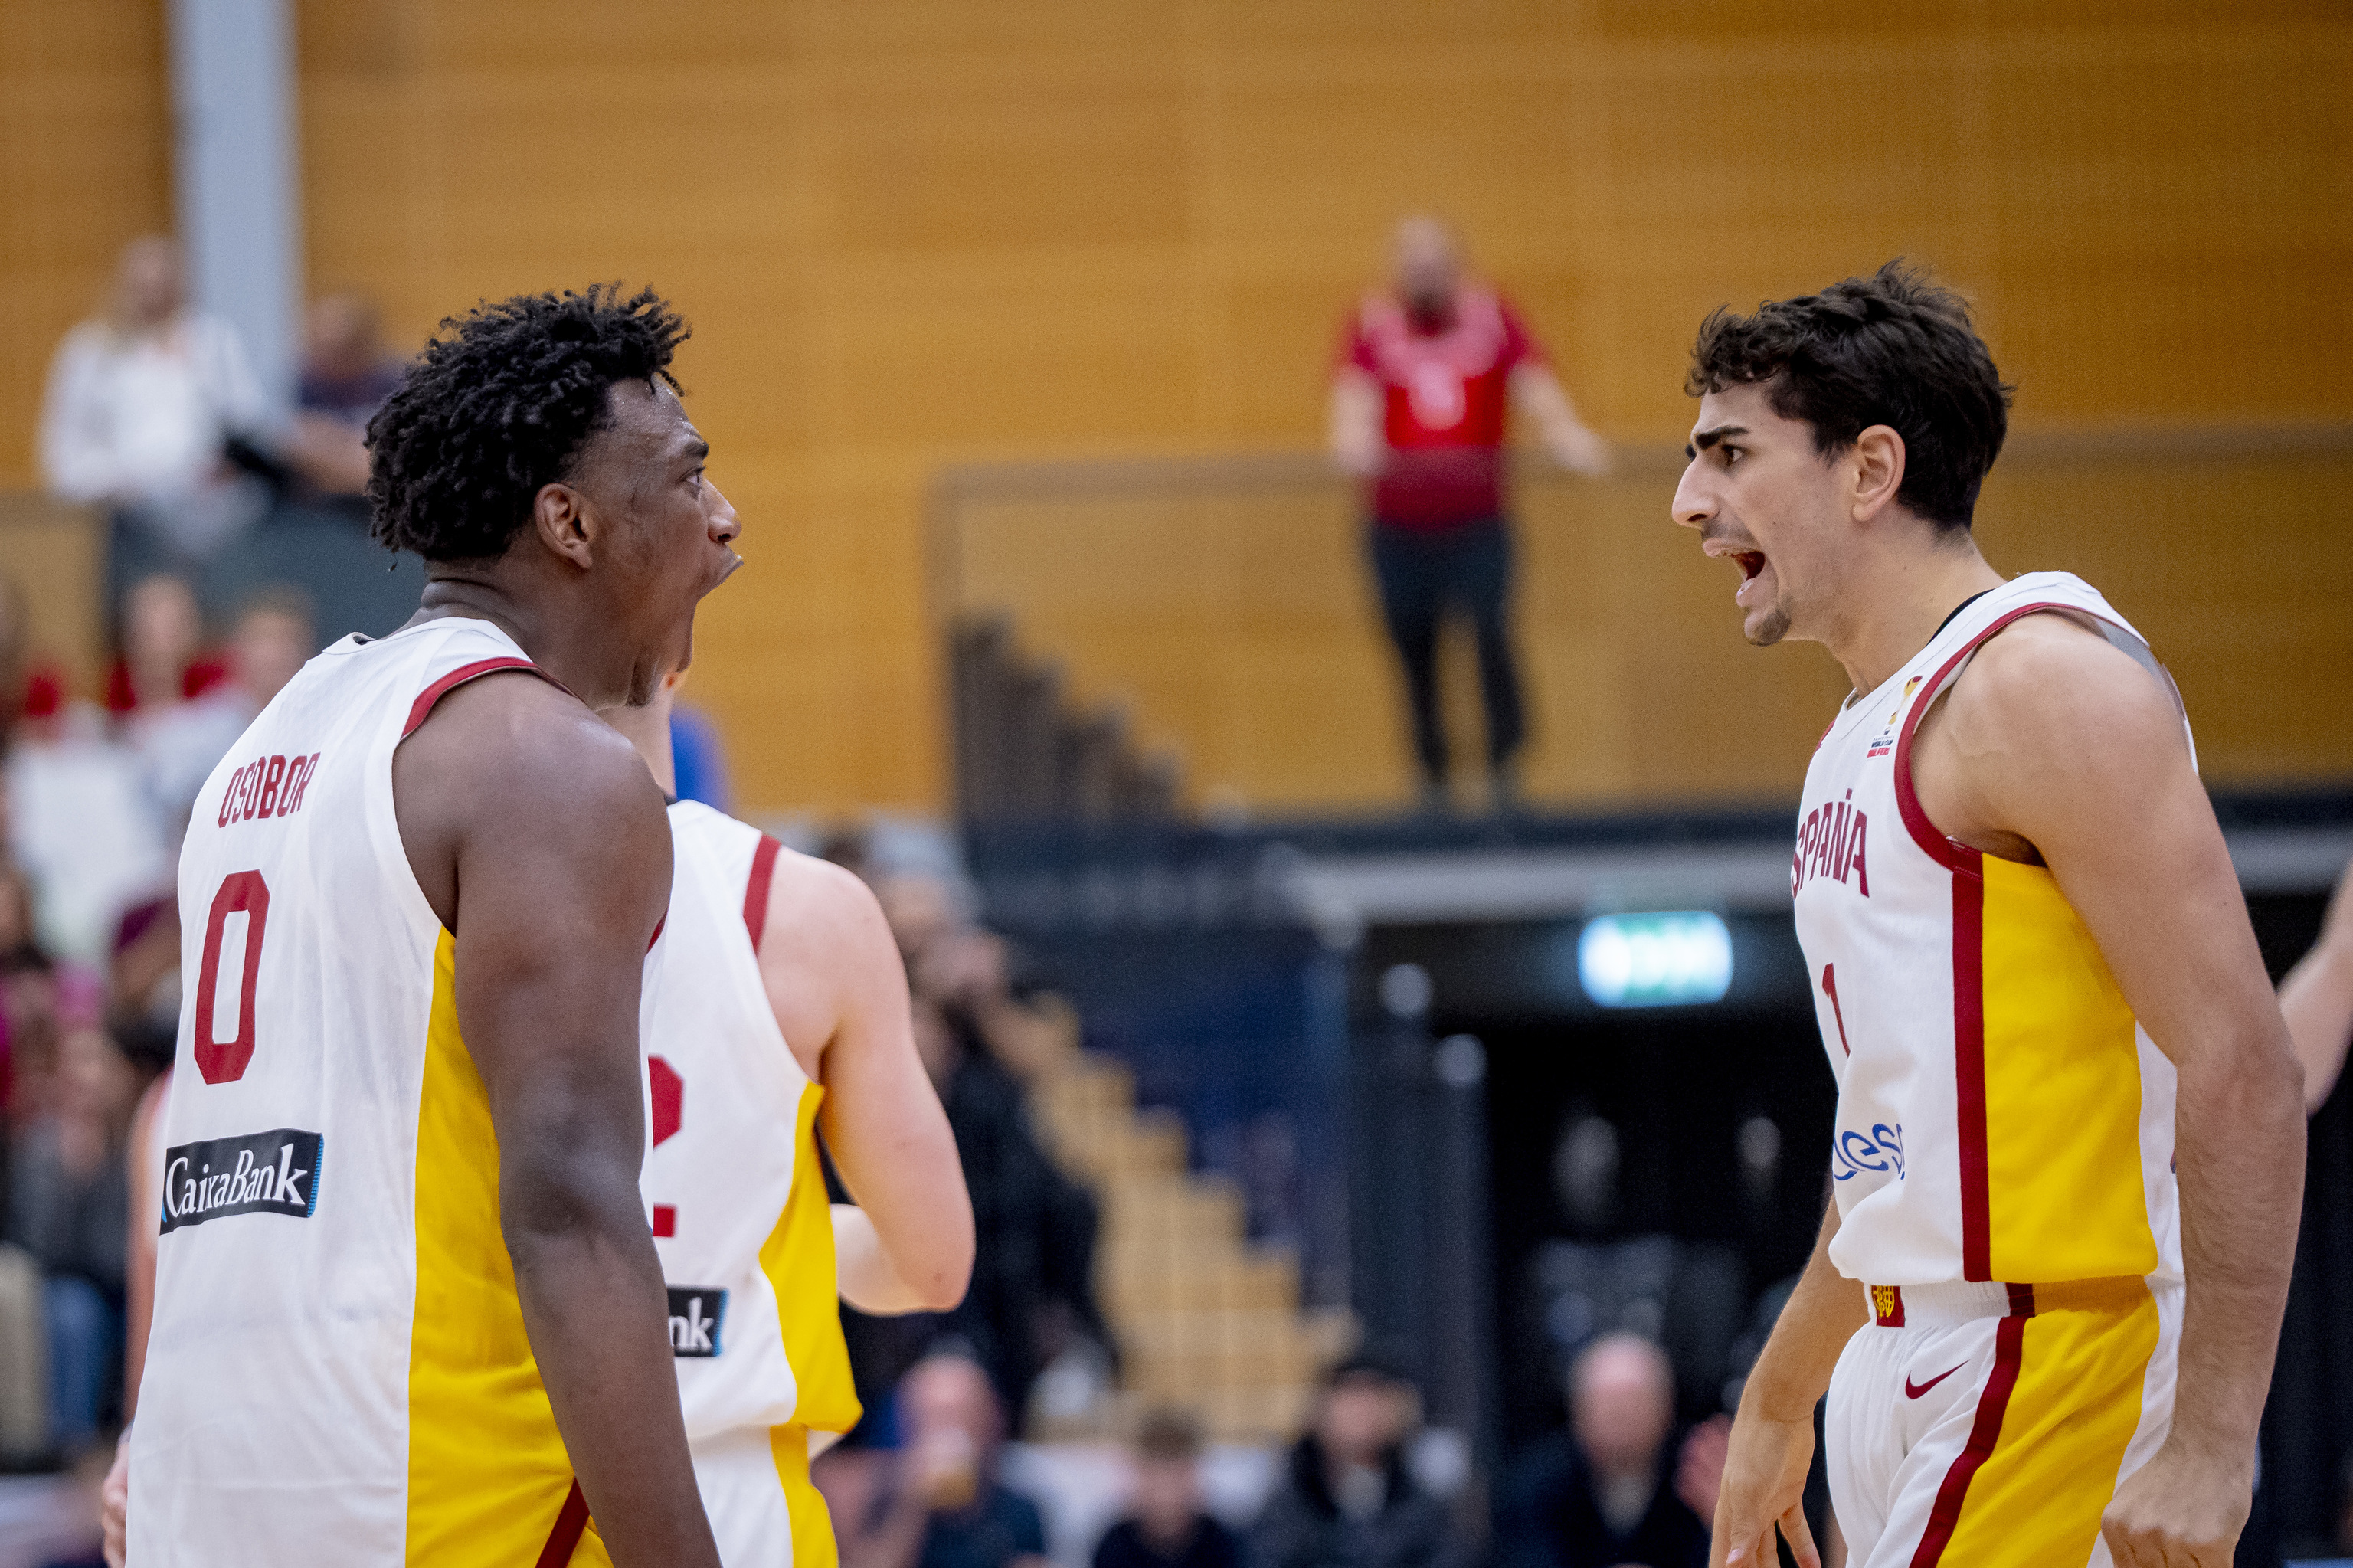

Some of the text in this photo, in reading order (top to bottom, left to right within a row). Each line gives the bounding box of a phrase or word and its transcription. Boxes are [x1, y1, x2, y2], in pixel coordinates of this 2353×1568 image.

[218, 751, 321, 828] OSOBOR
[1791, 787, 1870, 899] SPAÑA
[194, 869, 270, 1085] 0
[166, 1143, 308, 1218] CaixaBank
[668, 1296, 715, 1350] nk
